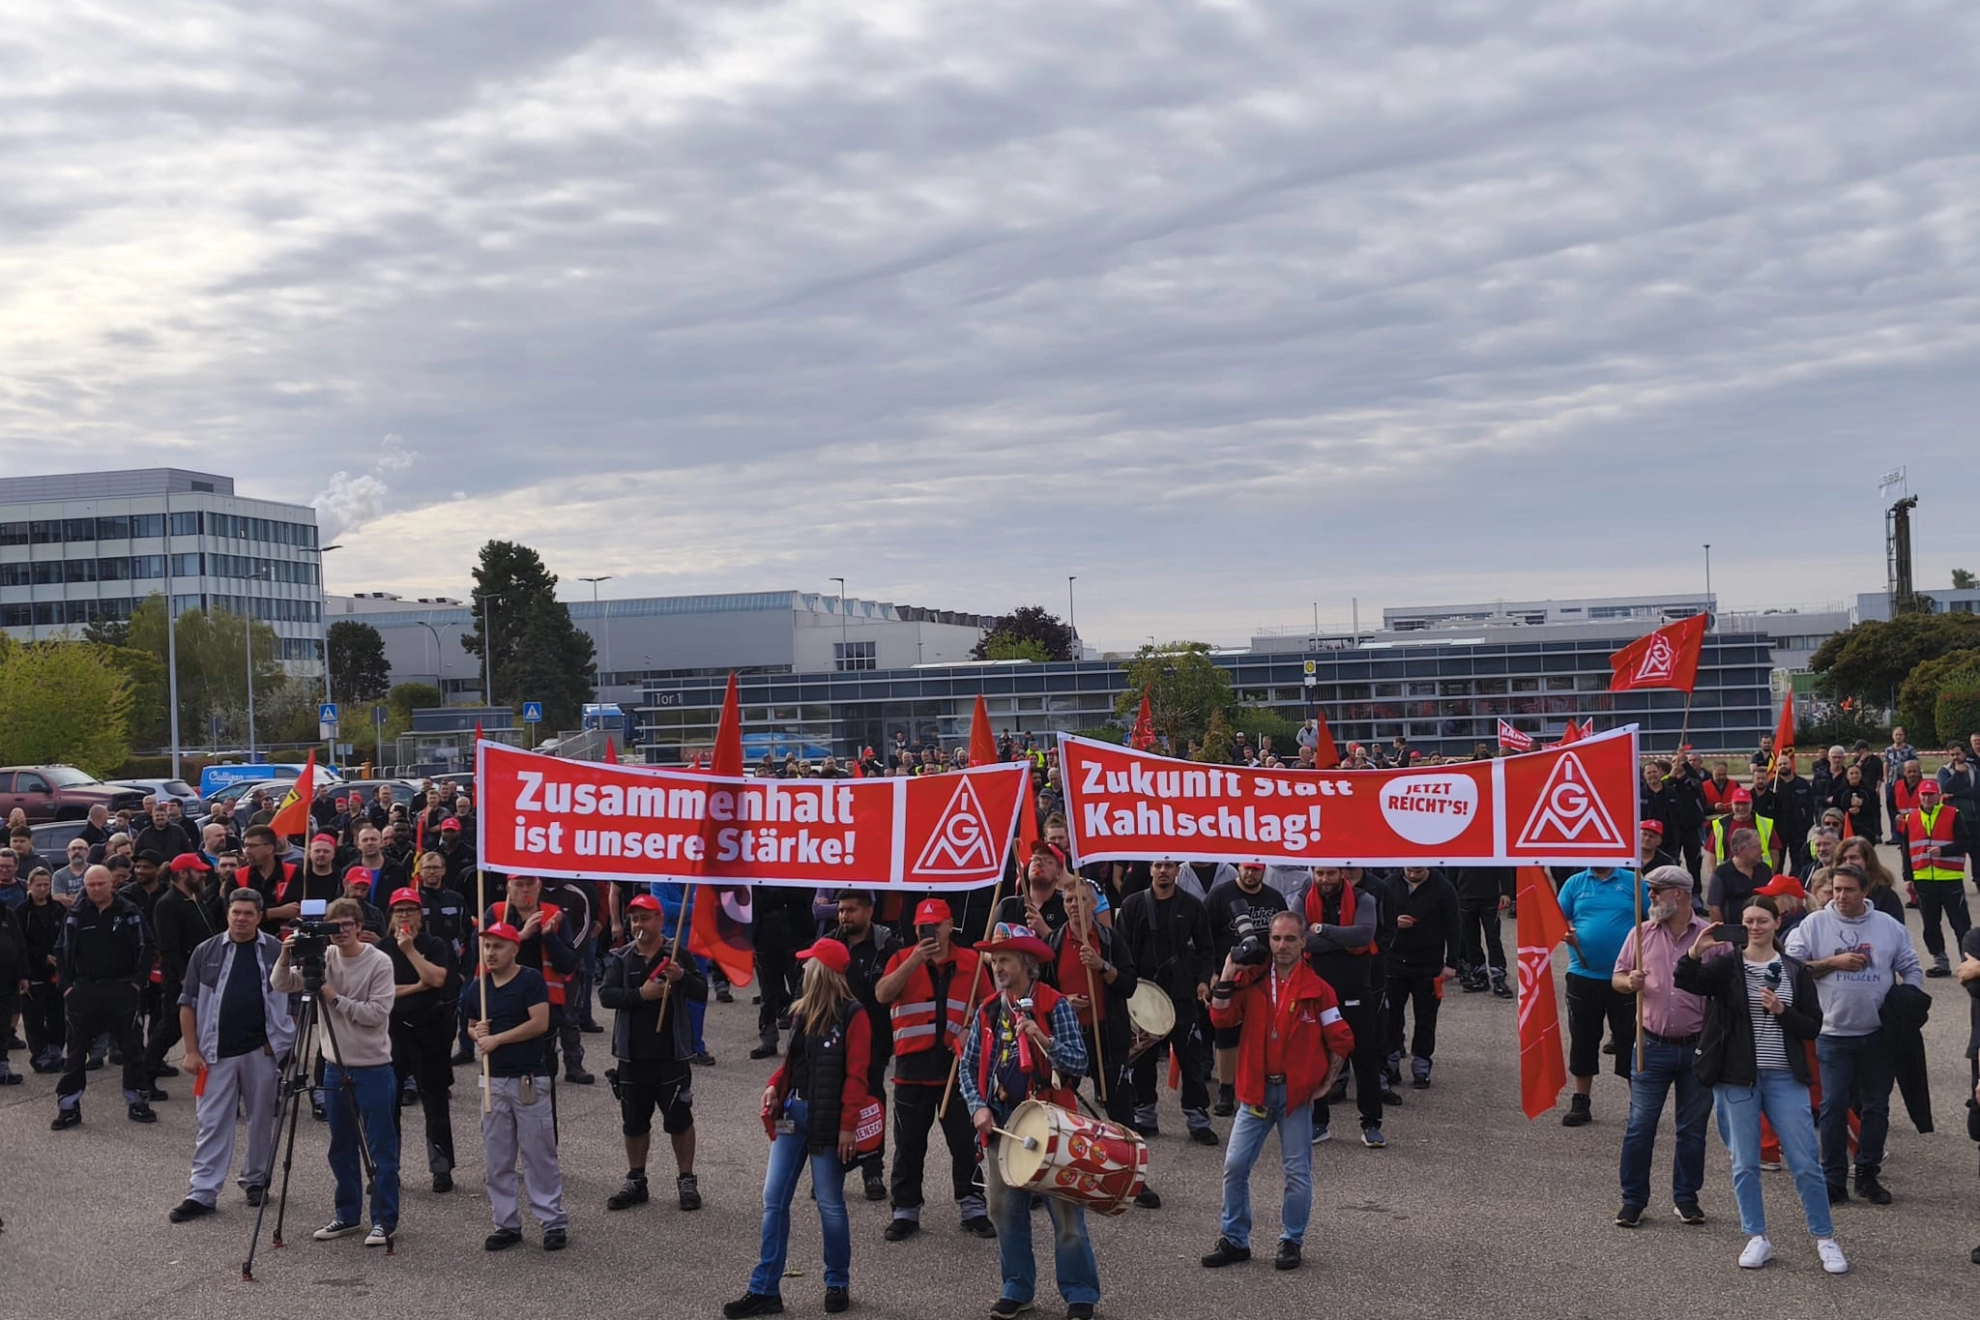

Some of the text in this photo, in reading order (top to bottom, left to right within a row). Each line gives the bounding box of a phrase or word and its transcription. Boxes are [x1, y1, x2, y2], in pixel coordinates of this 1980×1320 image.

[655, 692, 675, 705] Tor
[208, 770, 244, 786] Culligan
[1081, 760, 1242, 799] Zukunft
[1406, 782, 1452, 795] JETZT
[515, 770, 855, 825] Zusammenhalt
[1388, 795, 1469, 816] REICHT'S!
[514, 815, 856, 865] ist unsere Stärke!
[1083, 800, 1322, 851] Kahlschlag!
